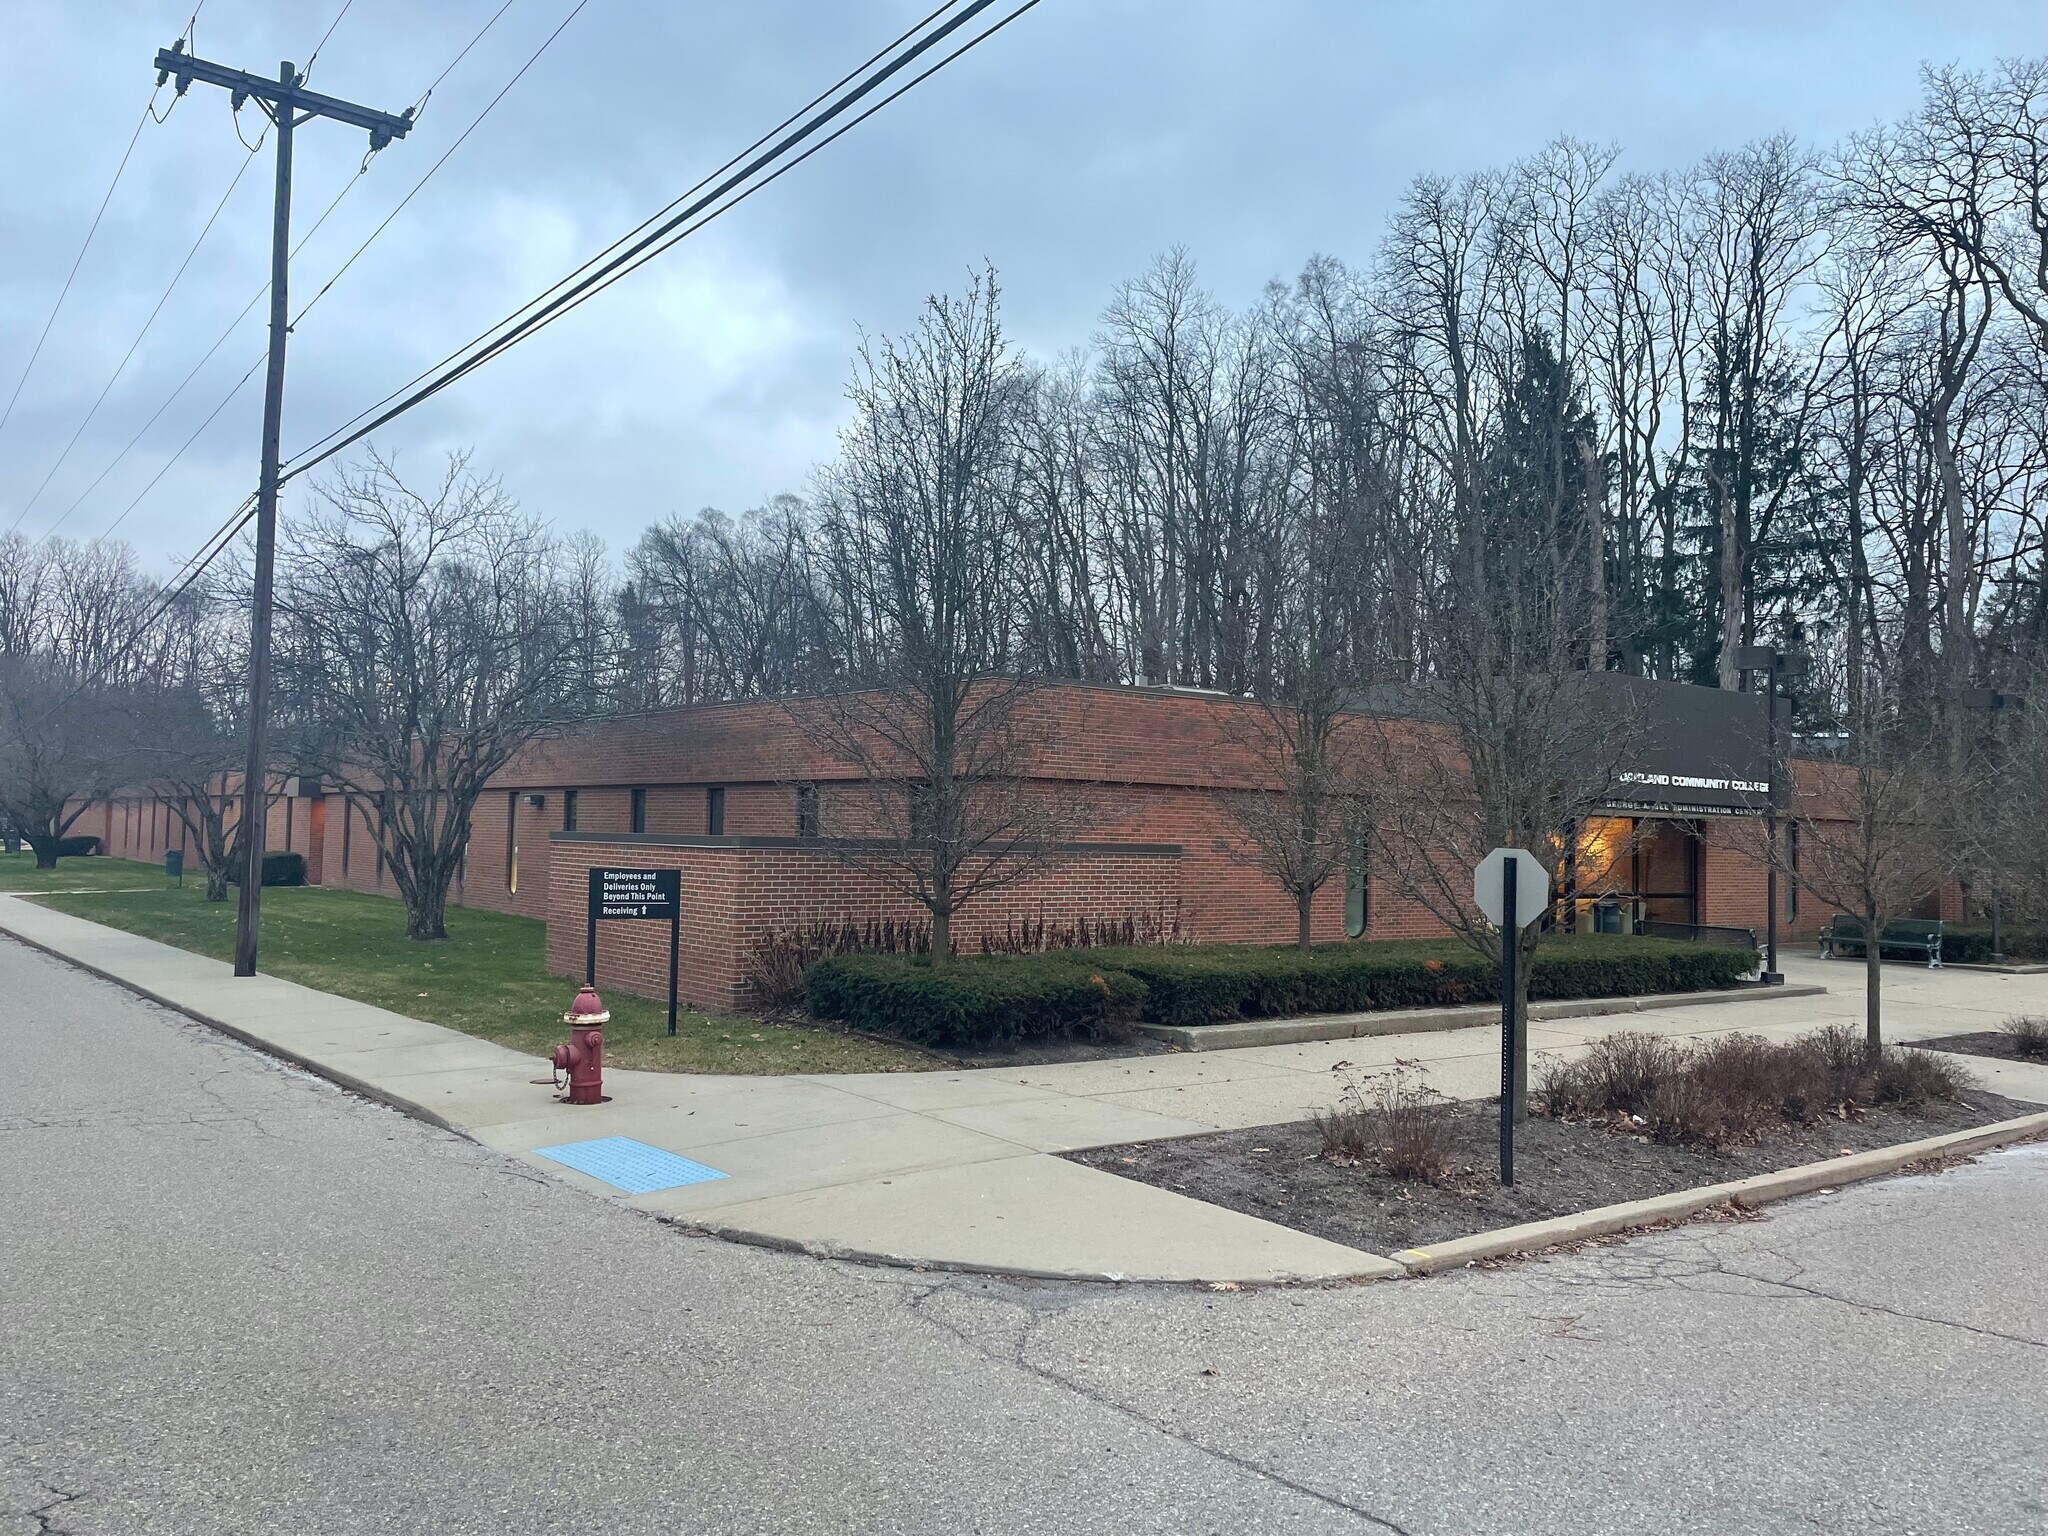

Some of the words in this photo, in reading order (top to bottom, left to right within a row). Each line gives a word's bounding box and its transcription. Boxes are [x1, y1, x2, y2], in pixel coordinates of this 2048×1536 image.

[1672, 775, 1729, 790] COMMUNITY
[1732, 780, 1769, 793] COLLEGE
[604, 872, 641, 881] Employees
[643, 872, 656, 880] and
[603, 883, 639, 891] Deliveries
[640, 883, 656, 892] Only
[603, 893, 630, 902] Beyond
[603, 907, 638, 916] Receiving
